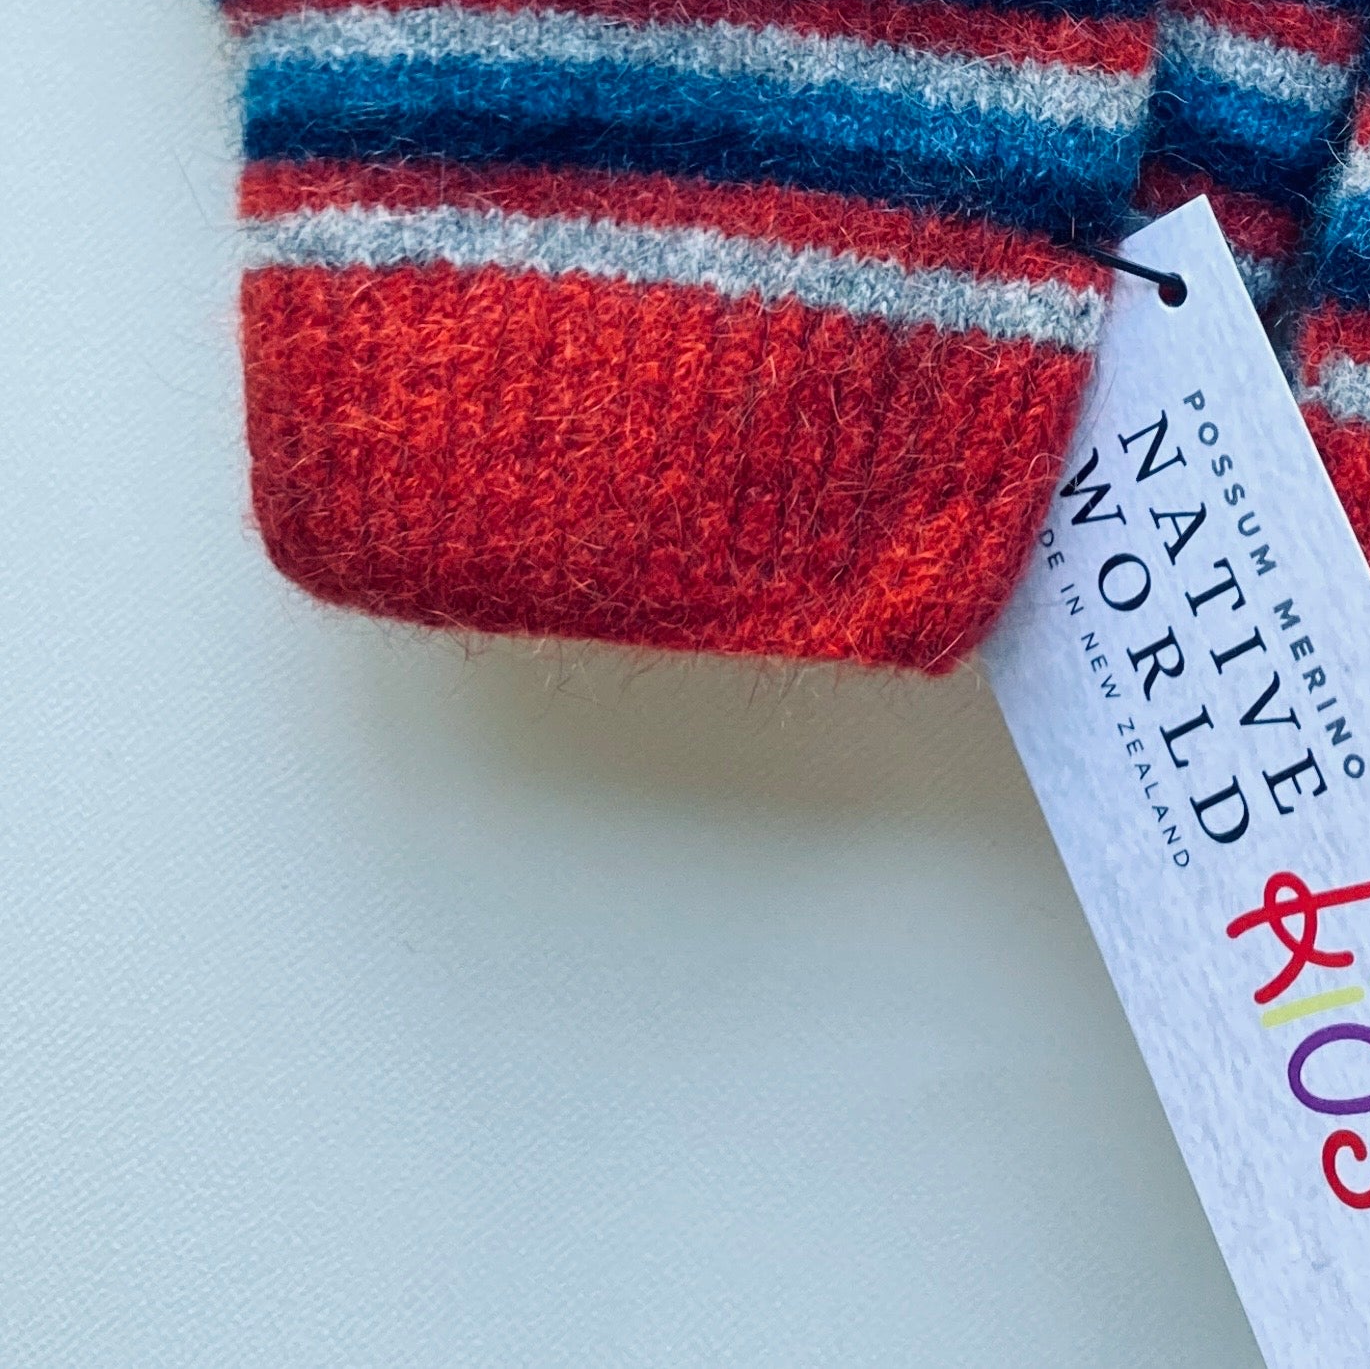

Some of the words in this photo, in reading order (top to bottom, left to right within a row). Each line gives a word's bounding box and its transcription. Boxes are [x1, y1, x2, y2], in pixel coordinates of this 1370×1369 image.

[1039, 528, 1065, 570] DE
[1060, 583, 1084, 616] IN
[1081, 632, 1121, 699] NEW
[1117, 717, 1190, 868] ZEALAND
[1060, 447, 1250, 844] WORLD
[1118, 409, 1328, 815] NATIVE
[1183, 389, 1278, 576] POSSUM
[1272, 598, 1366, 779] MERINO
